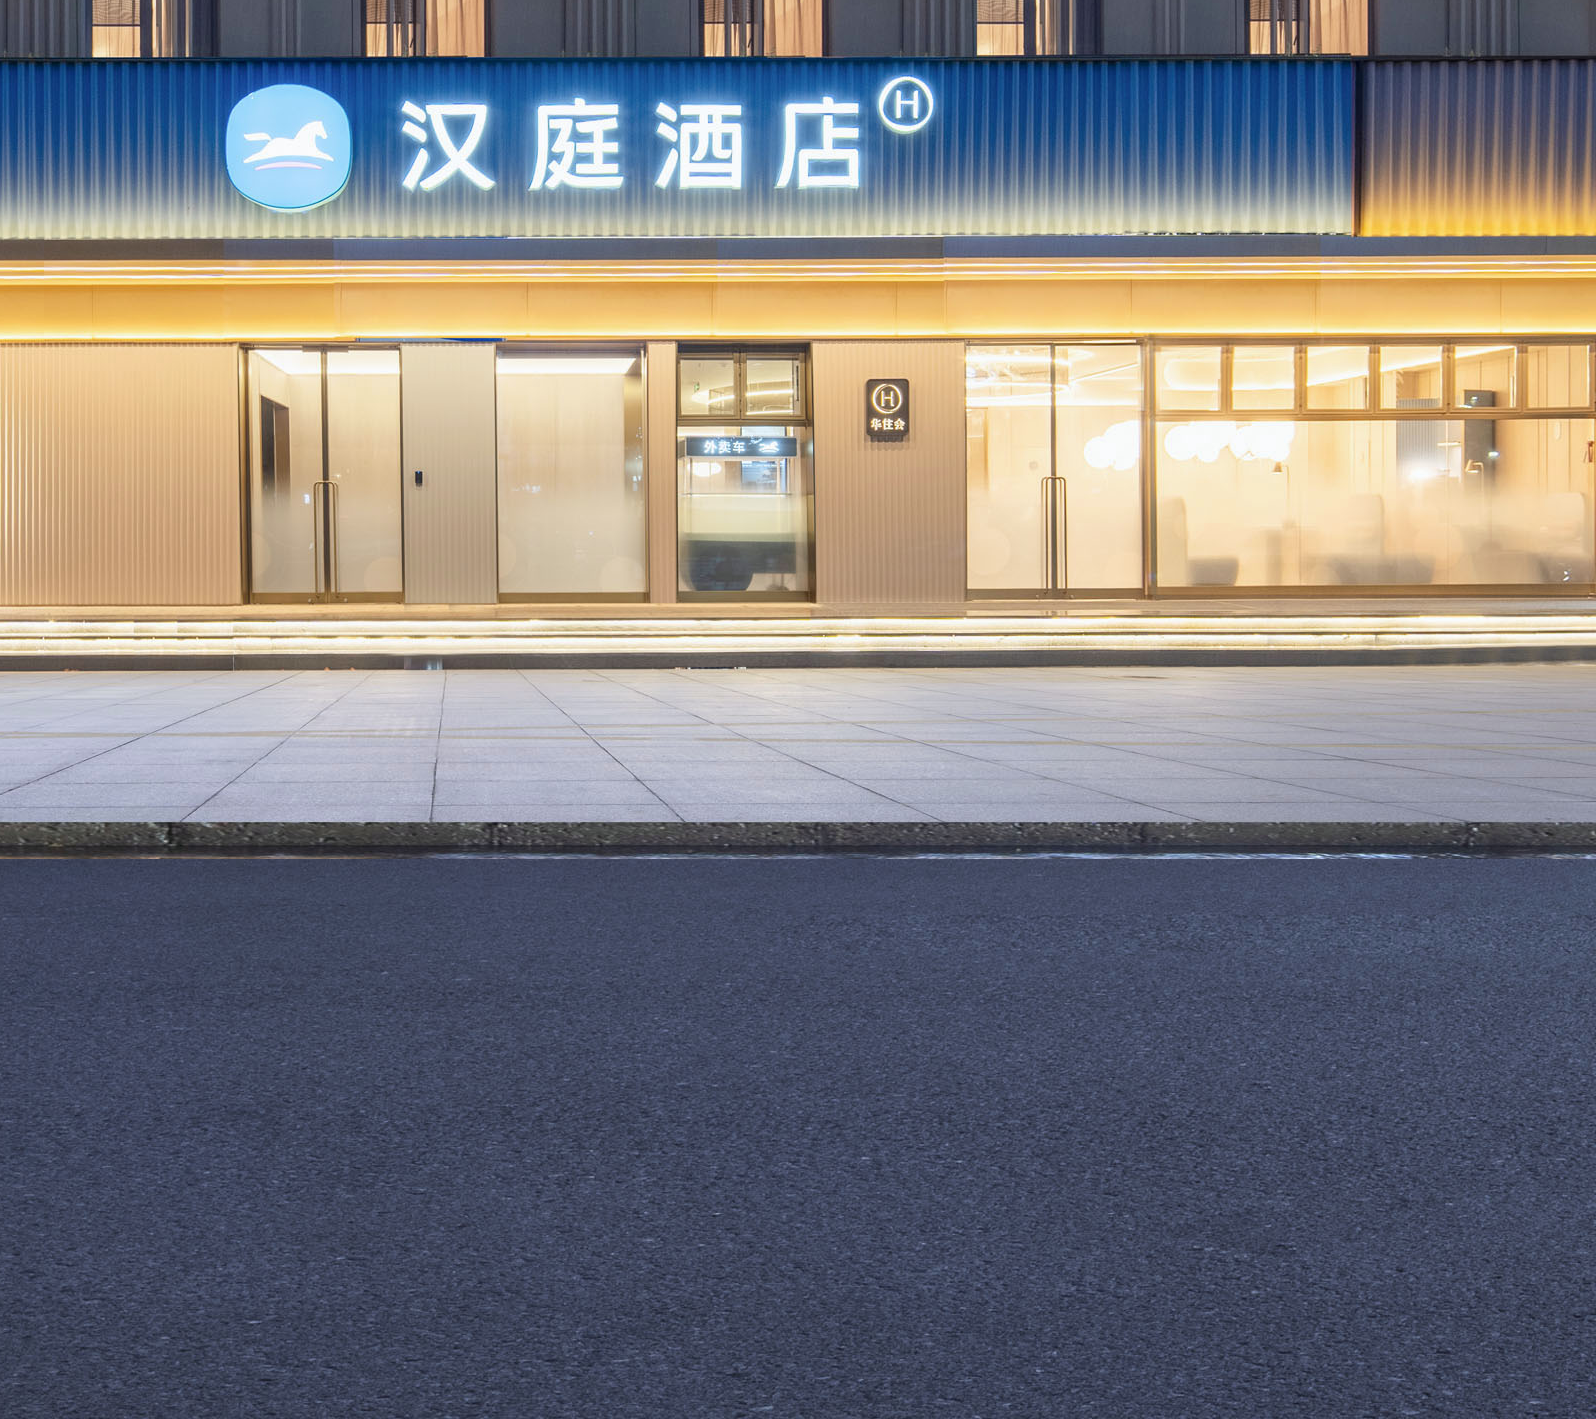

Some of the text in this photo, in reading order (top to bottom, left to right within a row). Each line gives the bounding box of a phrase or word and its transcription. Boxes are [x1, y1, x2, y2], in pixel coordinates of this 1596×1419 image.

[402, 96, 860, 191] 汉庭酒店
[870, 417, 906, 431] 华住会
[704, 439, 746, 454] 外卖车
